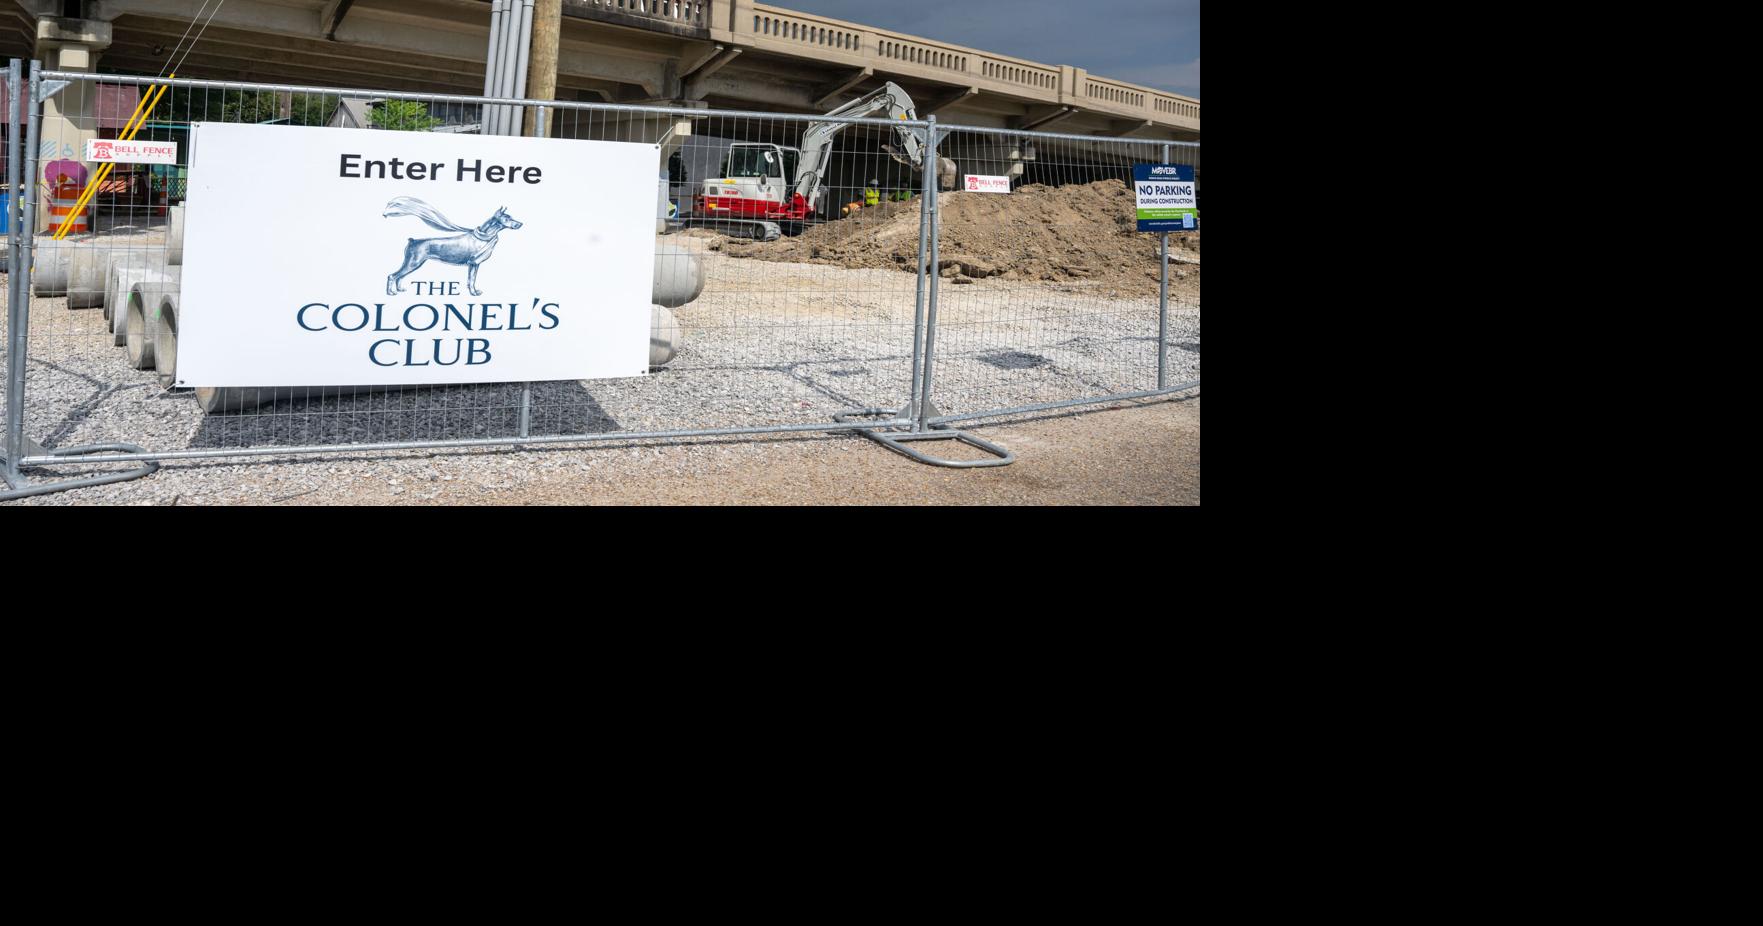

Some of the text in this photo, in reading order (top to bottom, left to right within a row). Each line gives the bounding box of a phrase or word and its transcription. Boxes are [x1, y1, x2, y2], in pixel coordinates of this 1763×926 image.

[114, 145, 139, 154] BELL
[143, 146, 173, 155] FENCE
[339, 153, 542, 184] Enter Here
[1139, 185, 1192, 196] NO PARKING
[410, 281, 460, 296] THE
[296, 297, 560, 332] COLONEL'S
[368, 338, 492, 367] CLUB
